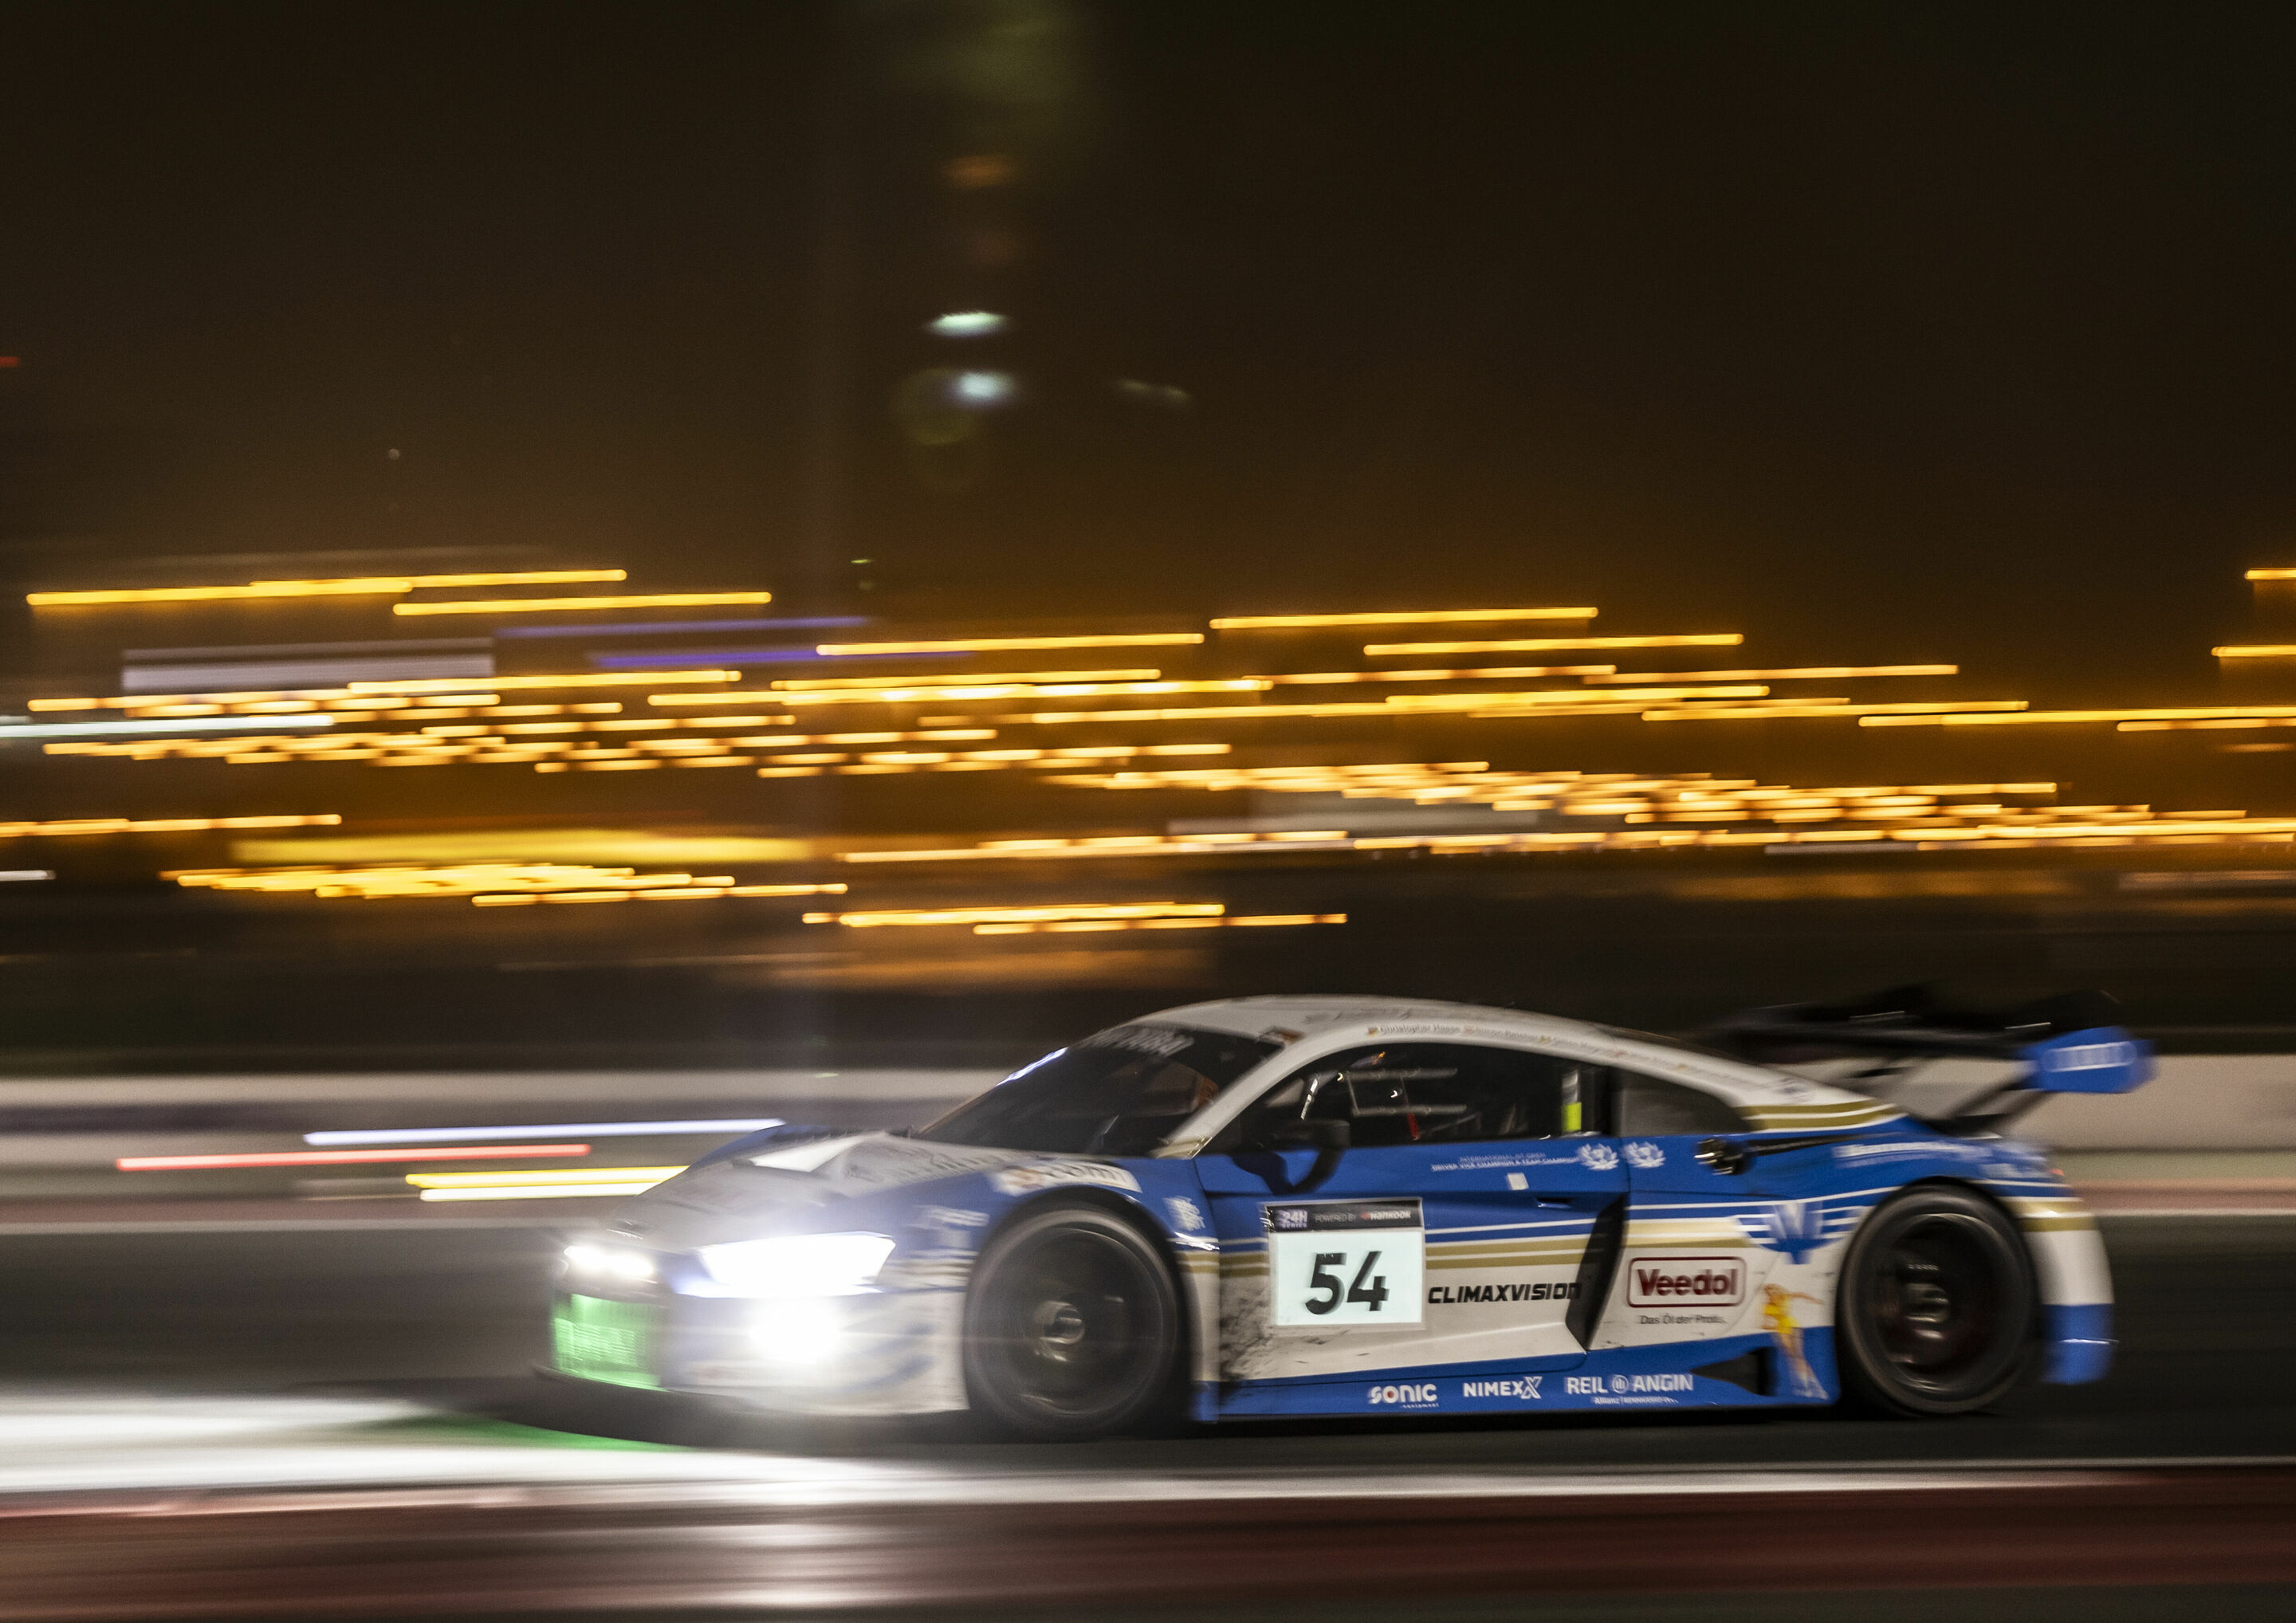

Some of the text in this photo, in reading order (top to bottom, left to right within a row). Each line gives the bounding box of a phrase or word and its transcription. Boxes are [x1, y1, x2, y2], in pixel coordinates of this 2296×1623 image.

[1305, 1250, 1390, 1315] 54
[1428, 1282, 1582, 1304] CLIMAXVISION
[1637, 1268, 1738, 1296] Veedol
[1640, 1315, 1660, 1325] Das
[1566, 1374, 1693, 1395] REIL ANGIN
